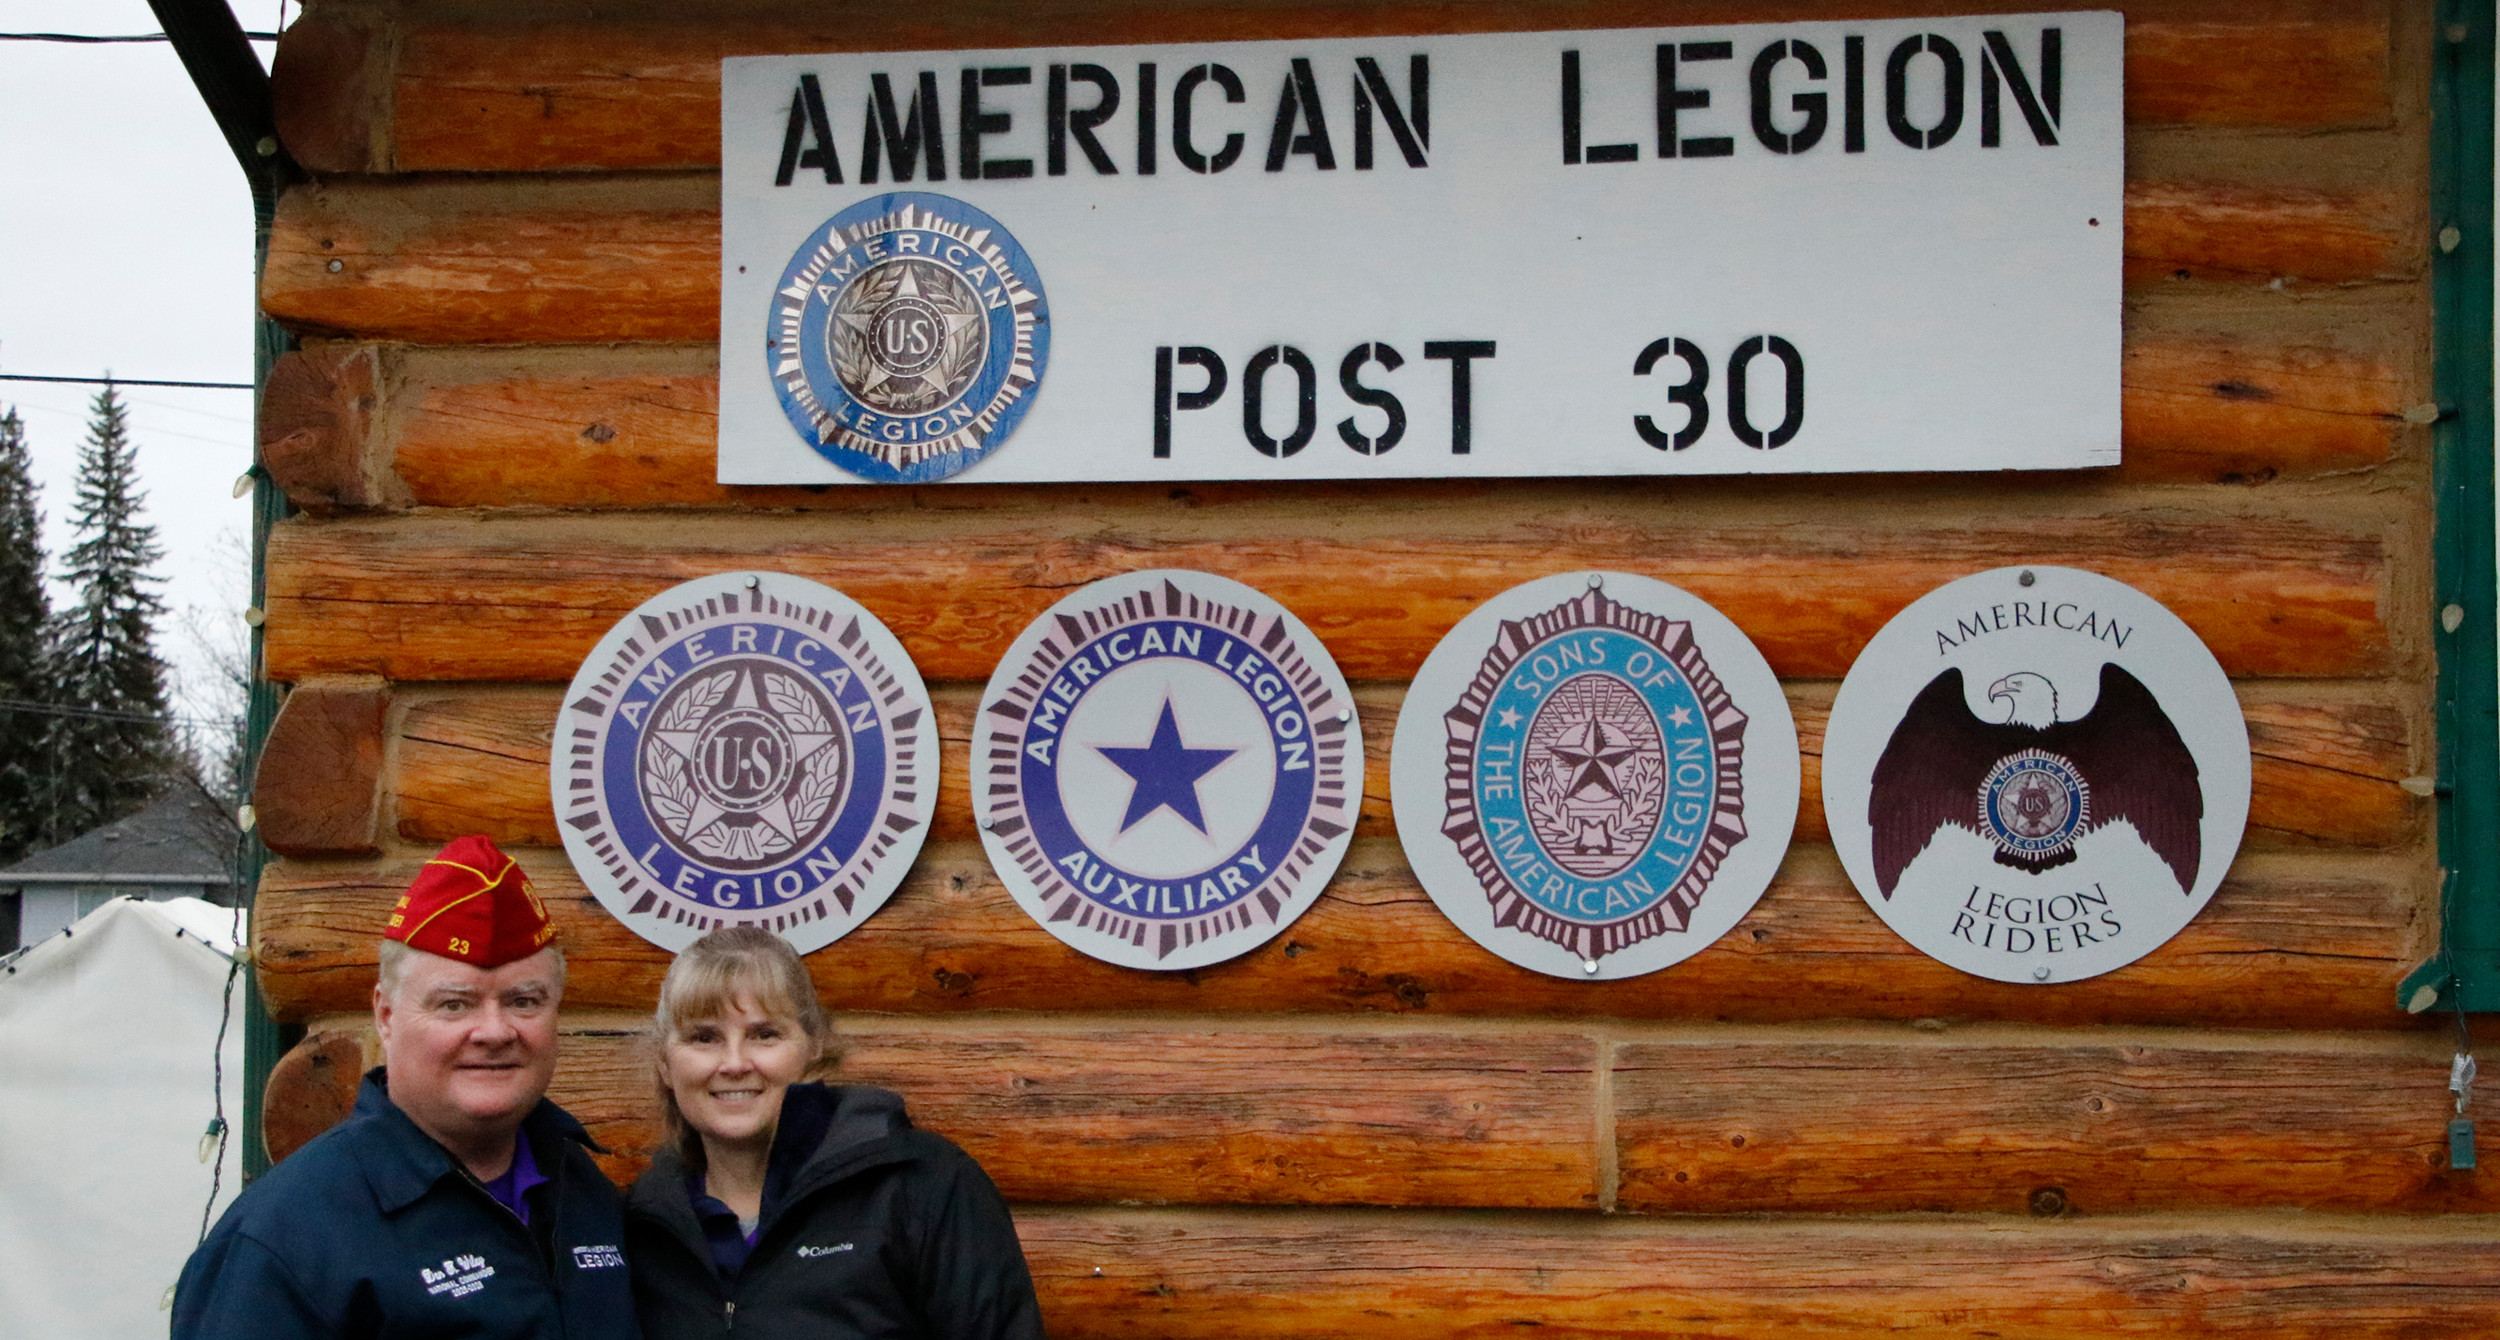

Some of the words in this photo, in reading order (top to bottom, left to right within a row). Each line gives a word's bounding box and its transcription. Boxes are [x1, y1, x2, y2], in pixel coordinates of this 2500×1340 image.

[775, 55, 1430, 187] AMERICAN
[1562, 28, 2061, 165] LEGION
[817, 233, 1007, 310] AMERICAN
[836, 401, 974, 440] LEGION
[1153, 340, 1497, 459] POST
[1633, 335, 1804, 451] 30
[1935, 601, 2134, 656] AMERICAN
[618, 624, 879, 734] AMERICAN
[1515, 637, 1606, 698] SONS
[1625, 651, 1676, 689] OF
[1026, 625, 1202, 767] AMERICAN
[1215, 641, 1310, 772] LEGION
[1483, 740, 1514, 800] THE
[1992, 760, 2077, 793] AMERICAN
[1655, 736, 1705, 867] LEGION
[1489, 816, 1654, 915] AMERICAN
[2003, 830, 2067, 850] LEGION
[639, 842, 842, 908] LEGION
[1058, 843, 1267, 914] AUXILIARY
[1964, 882, 2108, 924] LEGION
[448, 937, 470, 955] 23
[1950, 910, 2122, 954] RIDERS
[575, 1253, 625, 1268] LEGION
[810, 1242, 853, 1257] Columbia
